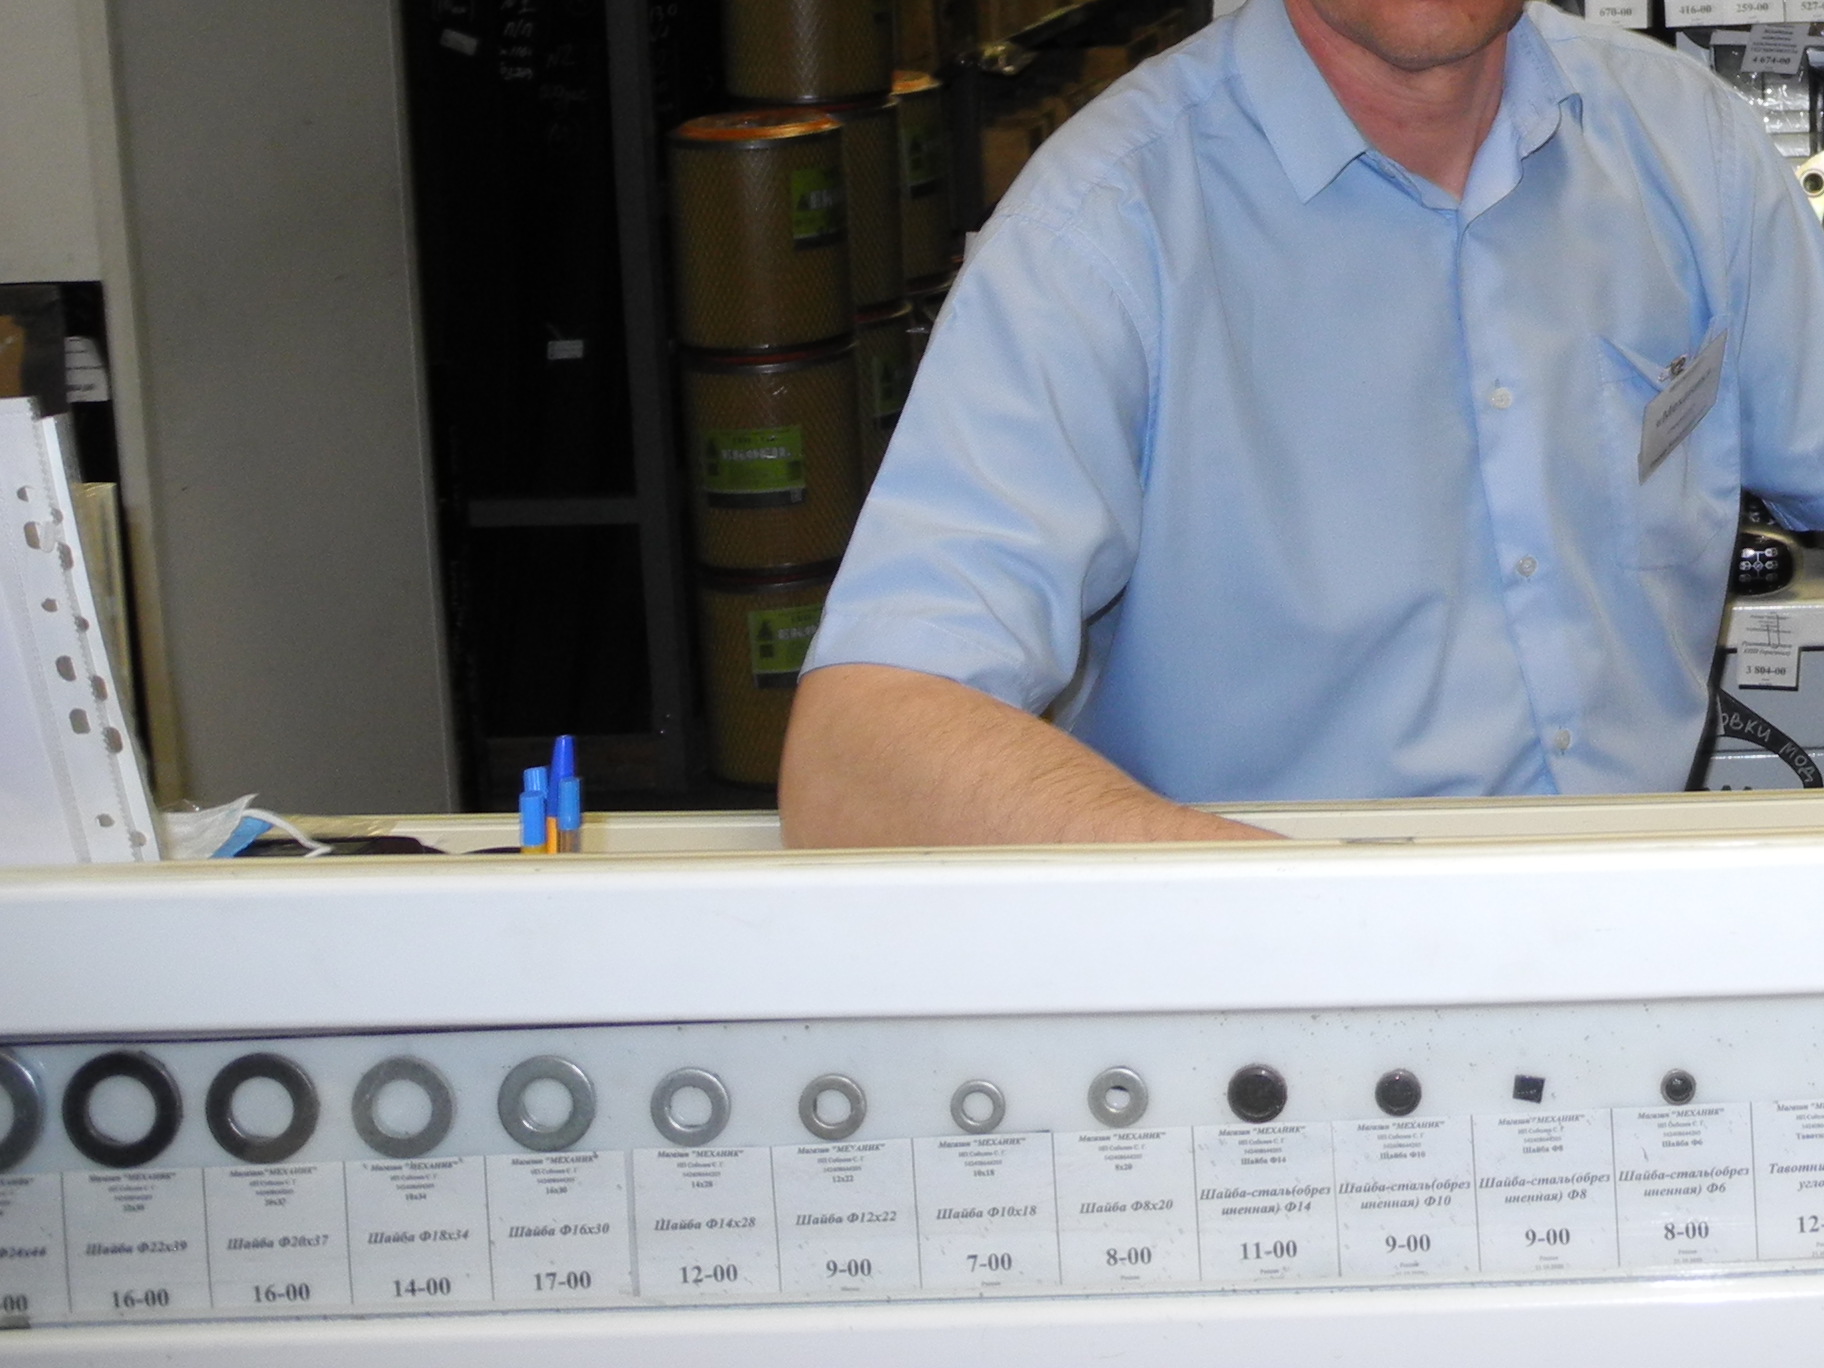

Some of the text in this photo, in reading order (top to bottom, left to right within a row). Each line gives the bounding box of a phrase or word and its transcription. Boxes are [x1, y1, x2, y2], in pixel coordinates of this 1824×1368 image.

[1478, 1170, 1611, 1189] Шайба-сталь(обрез
[1618, 1163, 1750, 1183] Шайба-сталь(обрез
[1200, 1184, 1332, 1202] Шайба-сталь(обрез
[1338, 1178, 1471, 1196] Шайба-сталь(обрез
[1503, 1187, 1588, 1205] иненная) Ф8
[1643, 1180, 1726, 1198] иненная) Ф6
[1079, 1201, 1127, 1215] Шайба
[1221, 1200, 1312, 1218] иненная) Ф14
[1359, 1194, 1452, 1211] иненная) Ф10
[795, 1213, 844, 1227] Шайба
[936, 1207, 984, 1220] Шайба
[508, 1226, 555, 1238] Шайба
[654, 1218, 702, 1232] Шайба
[1663, 1220, 1710, 1241] 8-00
[227, 1237, 273, 1250] Шайба
[367, 1232, 415, 1244] Шайба
[1384, 1233, 1432, 1254] 9-00
[1524, 1226, 1571, 1248] 9-00
[86, 1243, 132, 1256] Шайба
[1105, 1247, 1152, 1267] 8-00
[1239, 1240, 1298, 1261] 11-00
[825, 1259, 872, 1278] 9-00
[966, 1253, 1013, 1273] 7-00
[534, 1271, 592, 1291] 17-00
[680, 1264, 739, 1284] 12-00
[254, 1284, 310, 1303] 16-00
[393, 1277, 451, 1297] 14-00
[112, 1288, 169, 1308] 16-00
